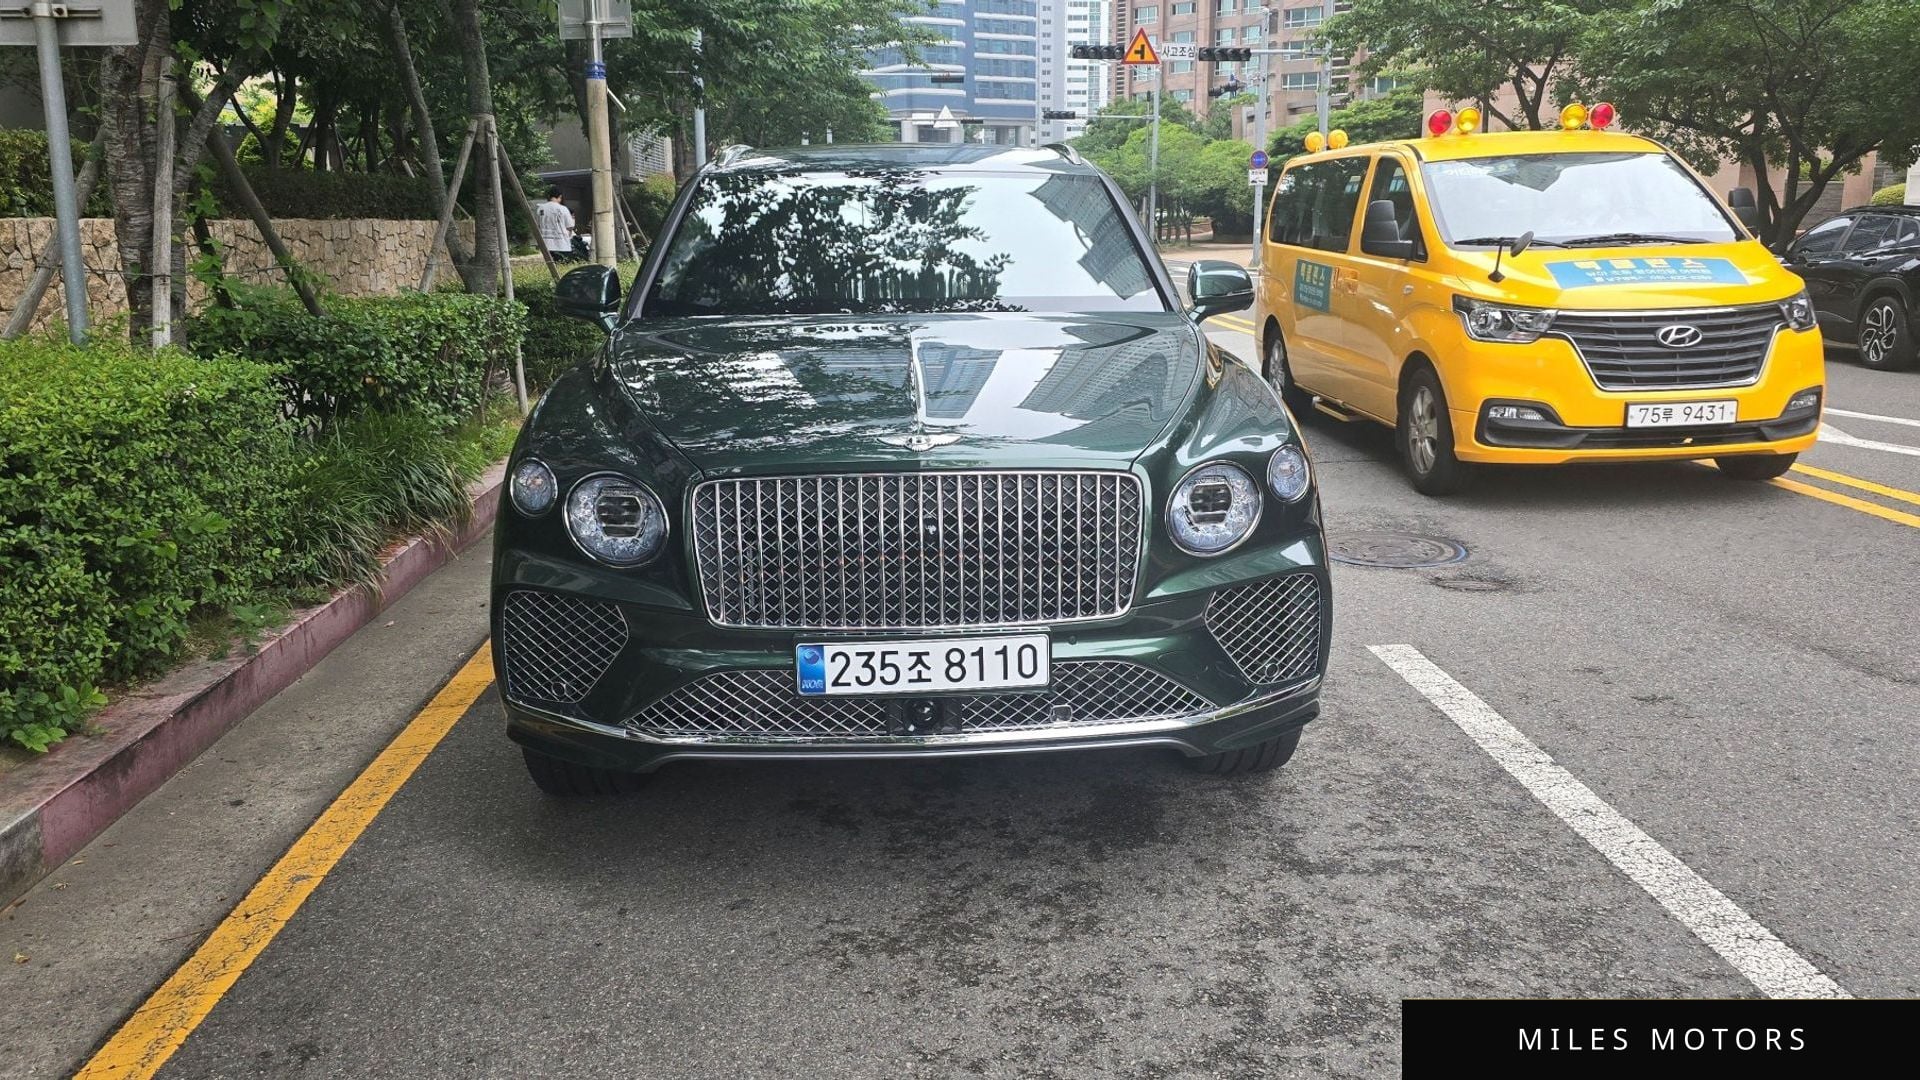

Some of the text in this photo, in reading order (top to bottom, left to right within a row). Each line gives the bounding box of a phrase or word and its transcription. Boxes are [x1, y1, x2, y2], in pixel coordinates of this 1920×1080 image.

[1162, 45, 1196, 58] 사고조심
[1639, 399, 1726, 424] 75루 9431
[829, 643, 1038, 688] 235조 8110
